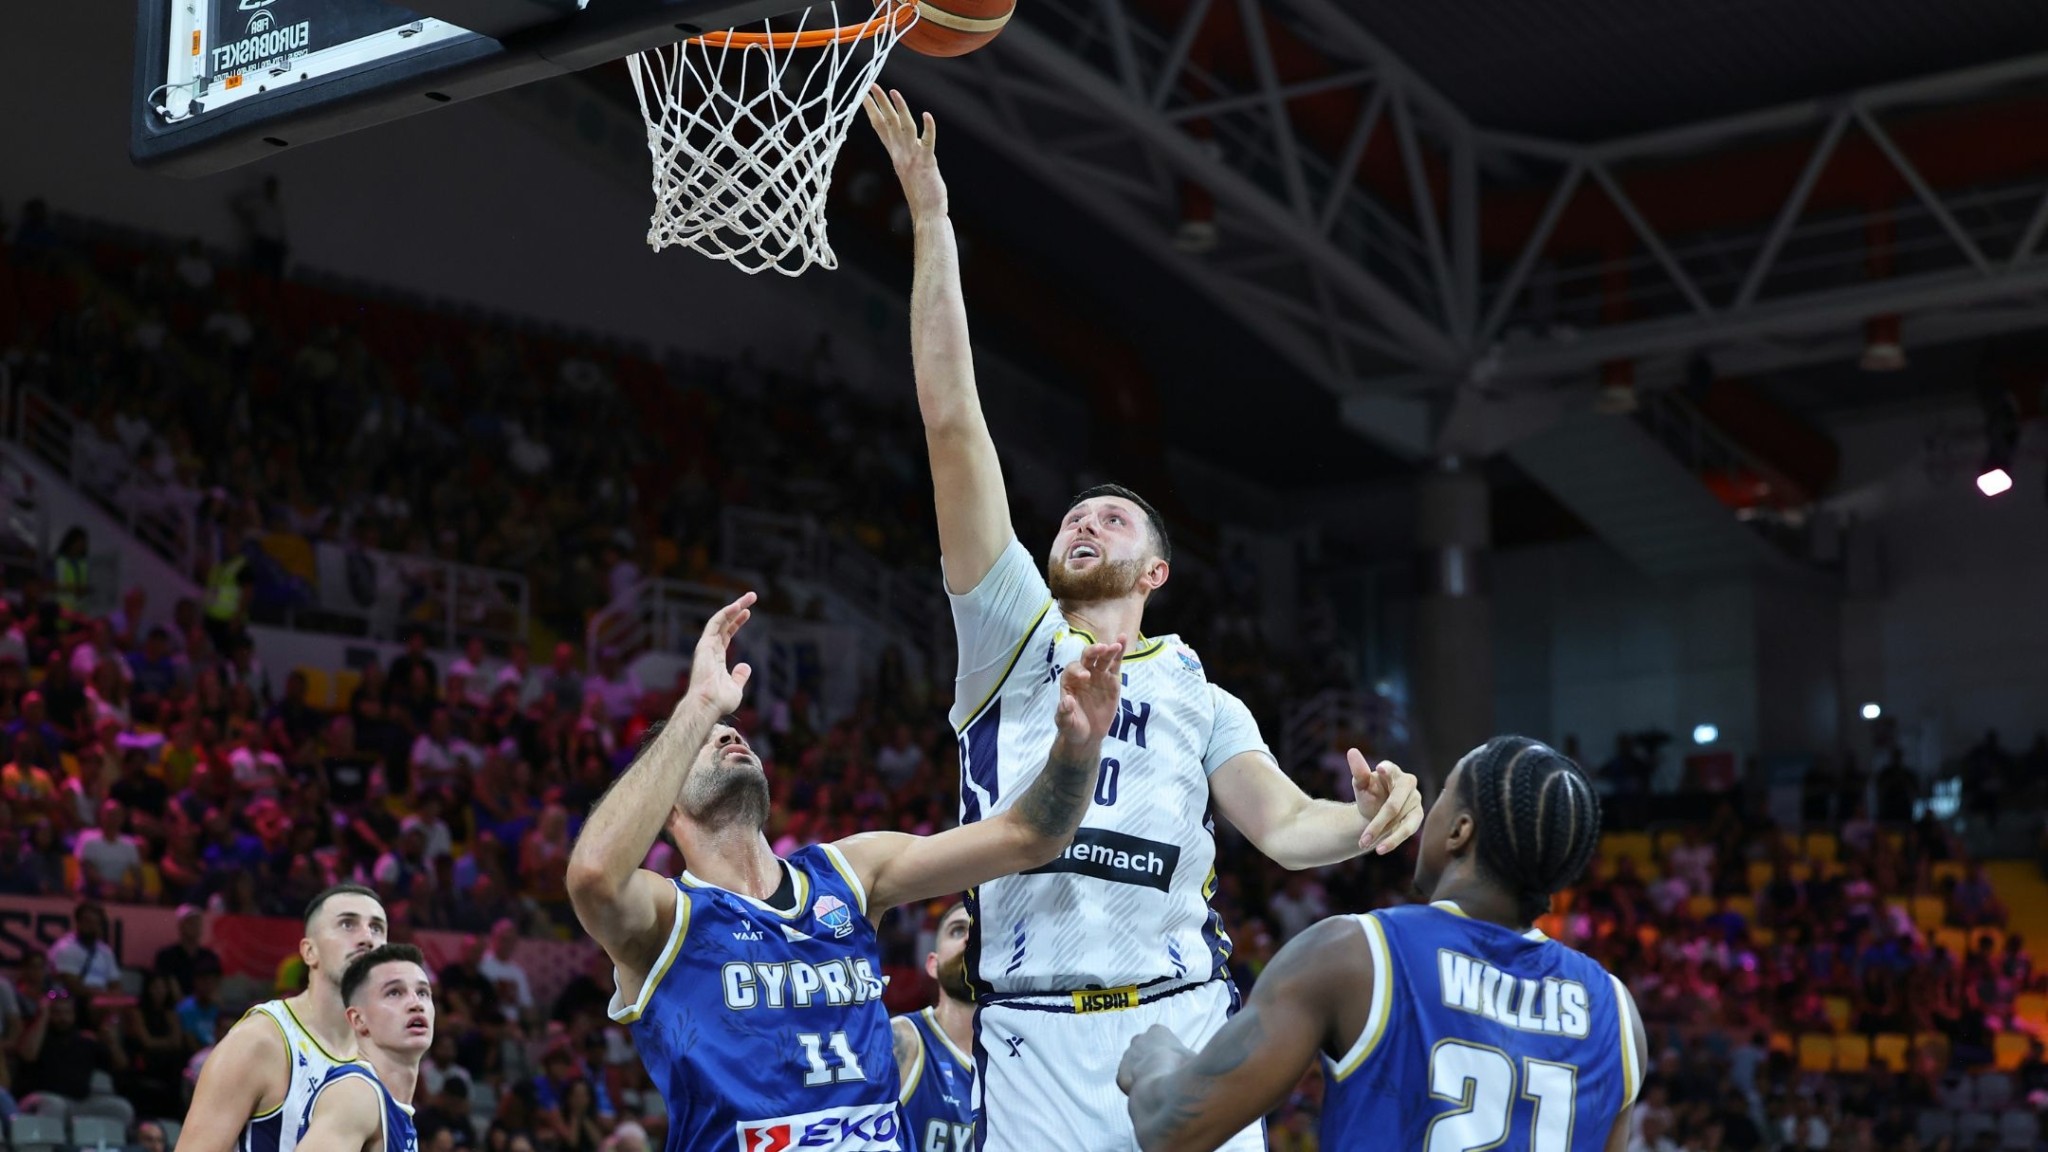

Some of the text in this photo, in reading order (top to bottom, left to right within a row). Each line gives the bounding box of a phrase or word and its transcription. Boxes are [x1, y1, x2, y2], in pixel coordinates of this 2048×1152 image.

[732, 931, 764, 941] VAAT
[1081, 992, 1129, 1011] HSBIH
[1438, 948, 1590, 1039] WILLIS
[797, 1031, 867, 1087] 11
[1424, 1037, 1579, 1152] 21
[798, 1111, 897, 1147] EKO
